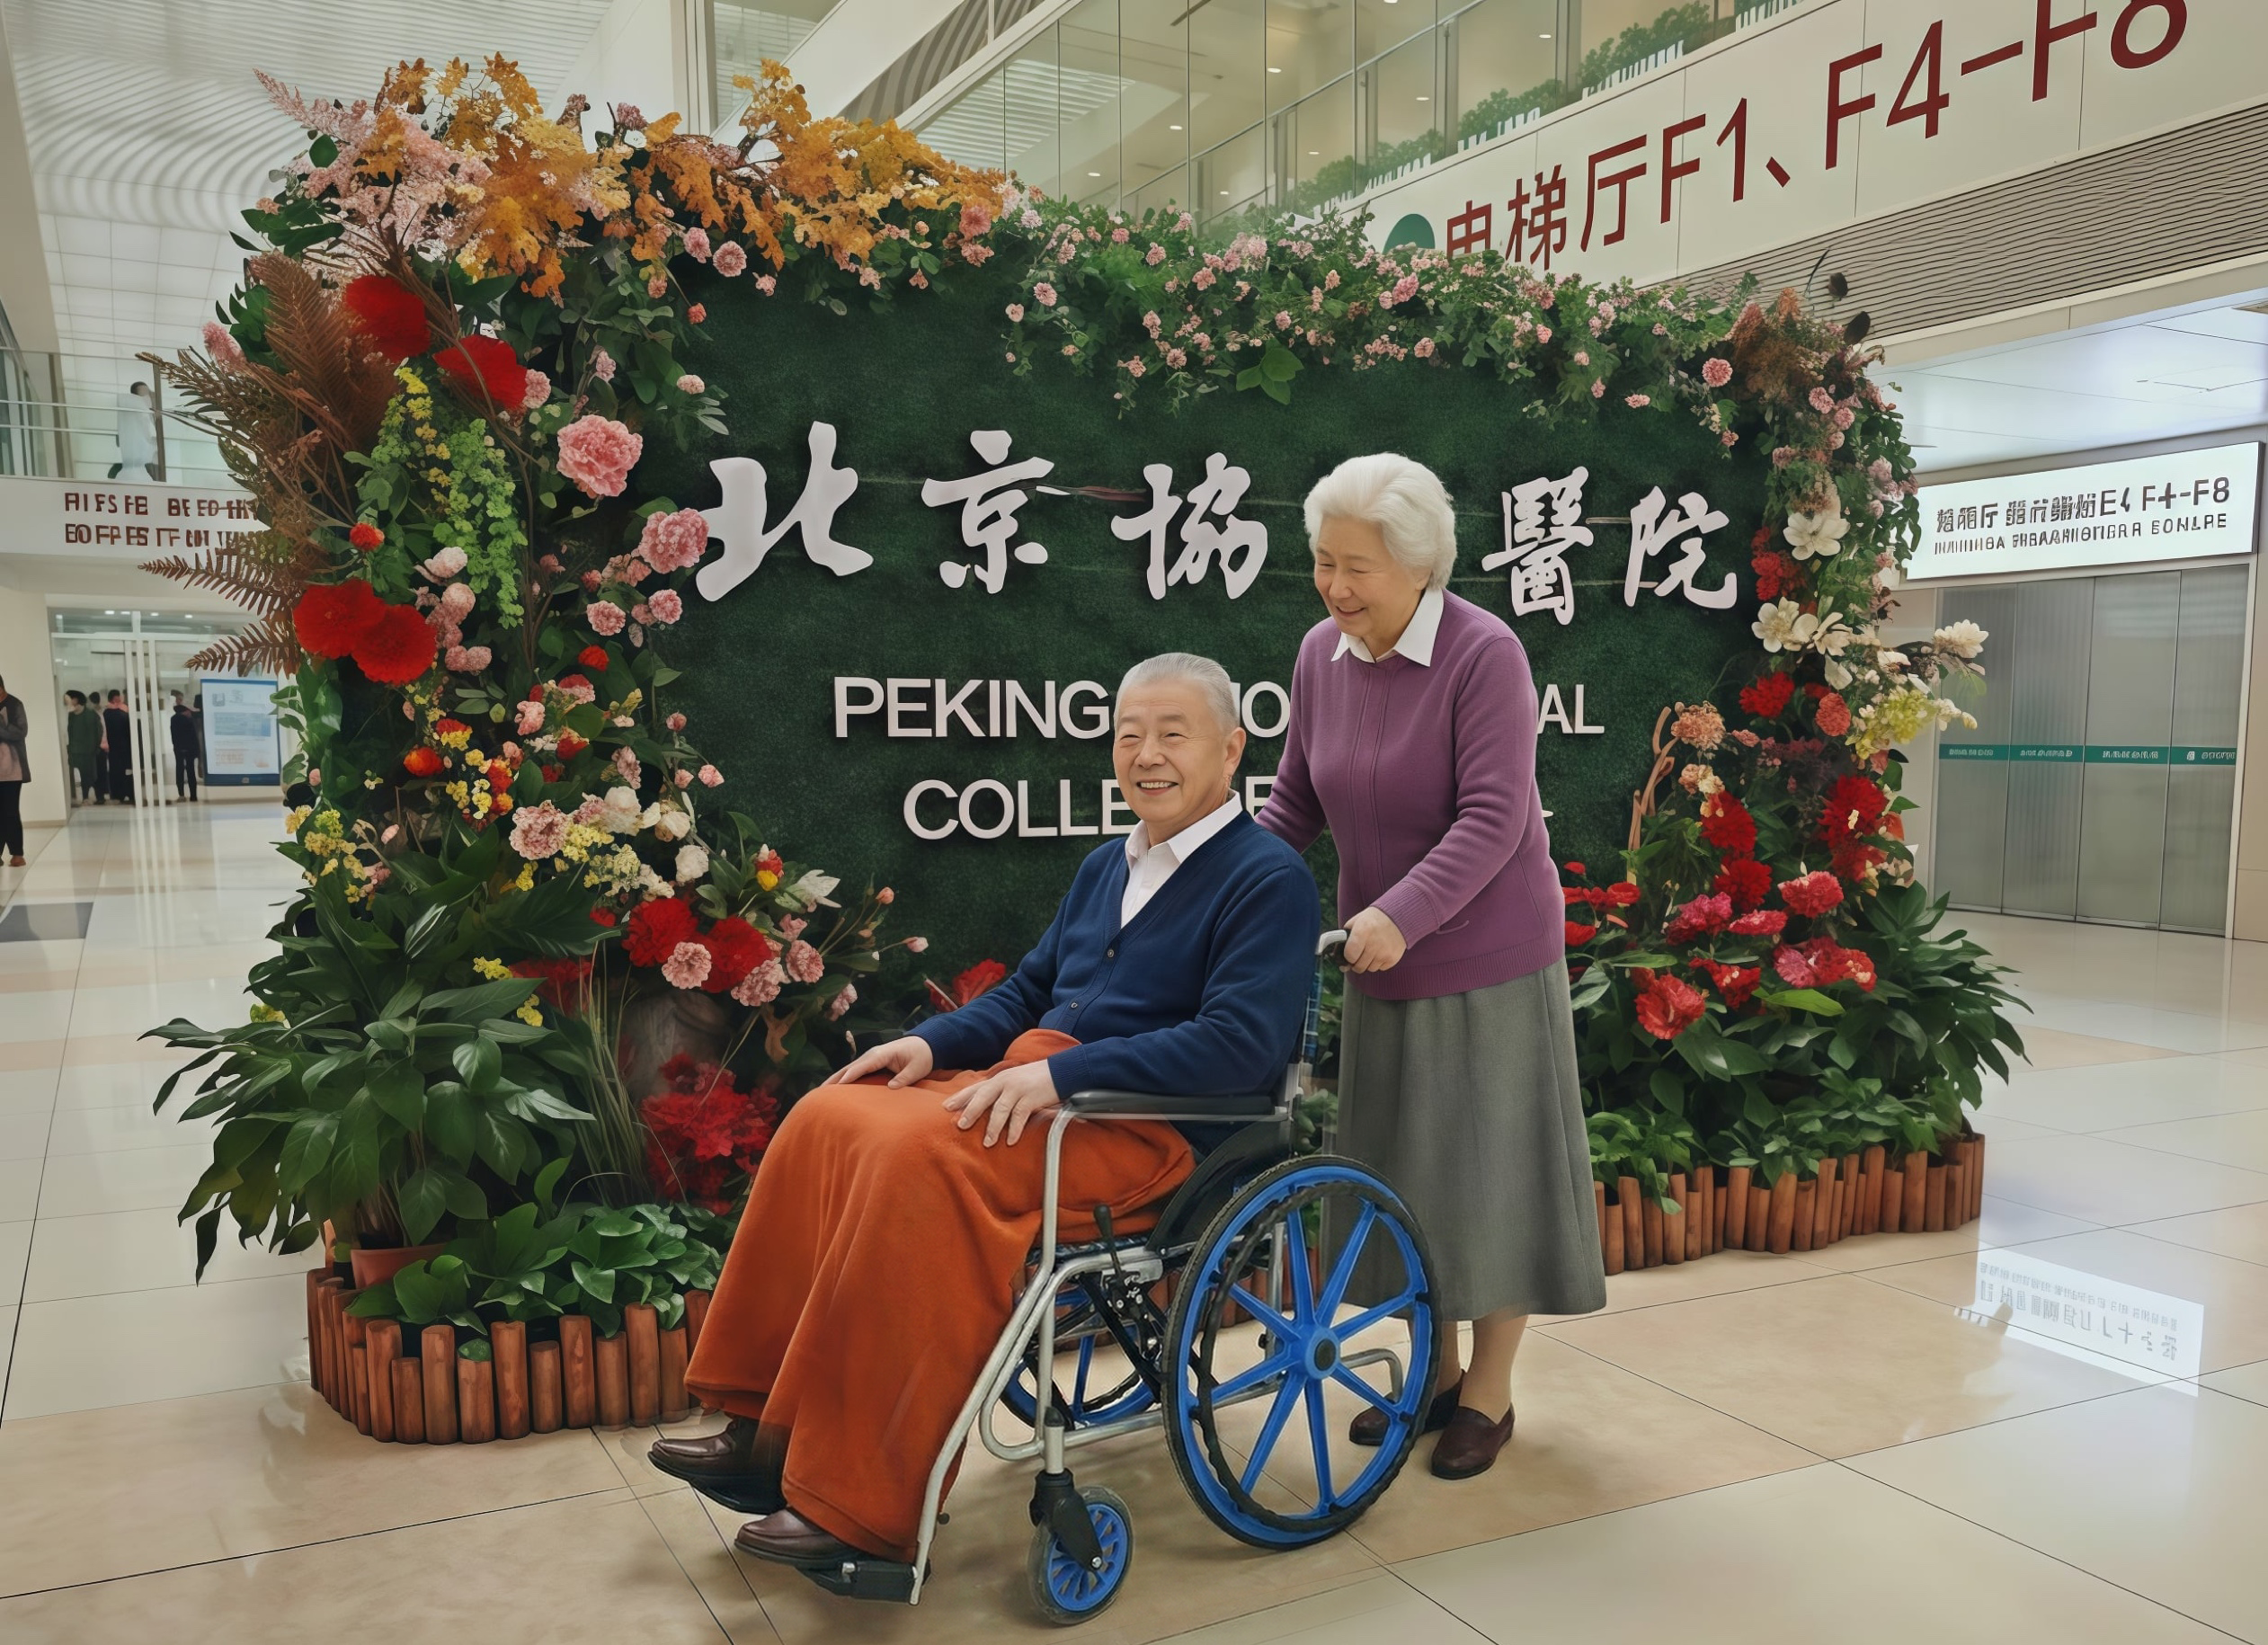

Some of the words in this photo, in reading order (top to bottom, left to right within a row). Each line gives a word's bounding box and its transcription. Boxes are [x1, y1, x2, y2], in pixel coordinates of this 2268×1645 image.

[696, 421, 1737, 624] 北京協醫院
[834, 677, 1108, 740] PEKING
